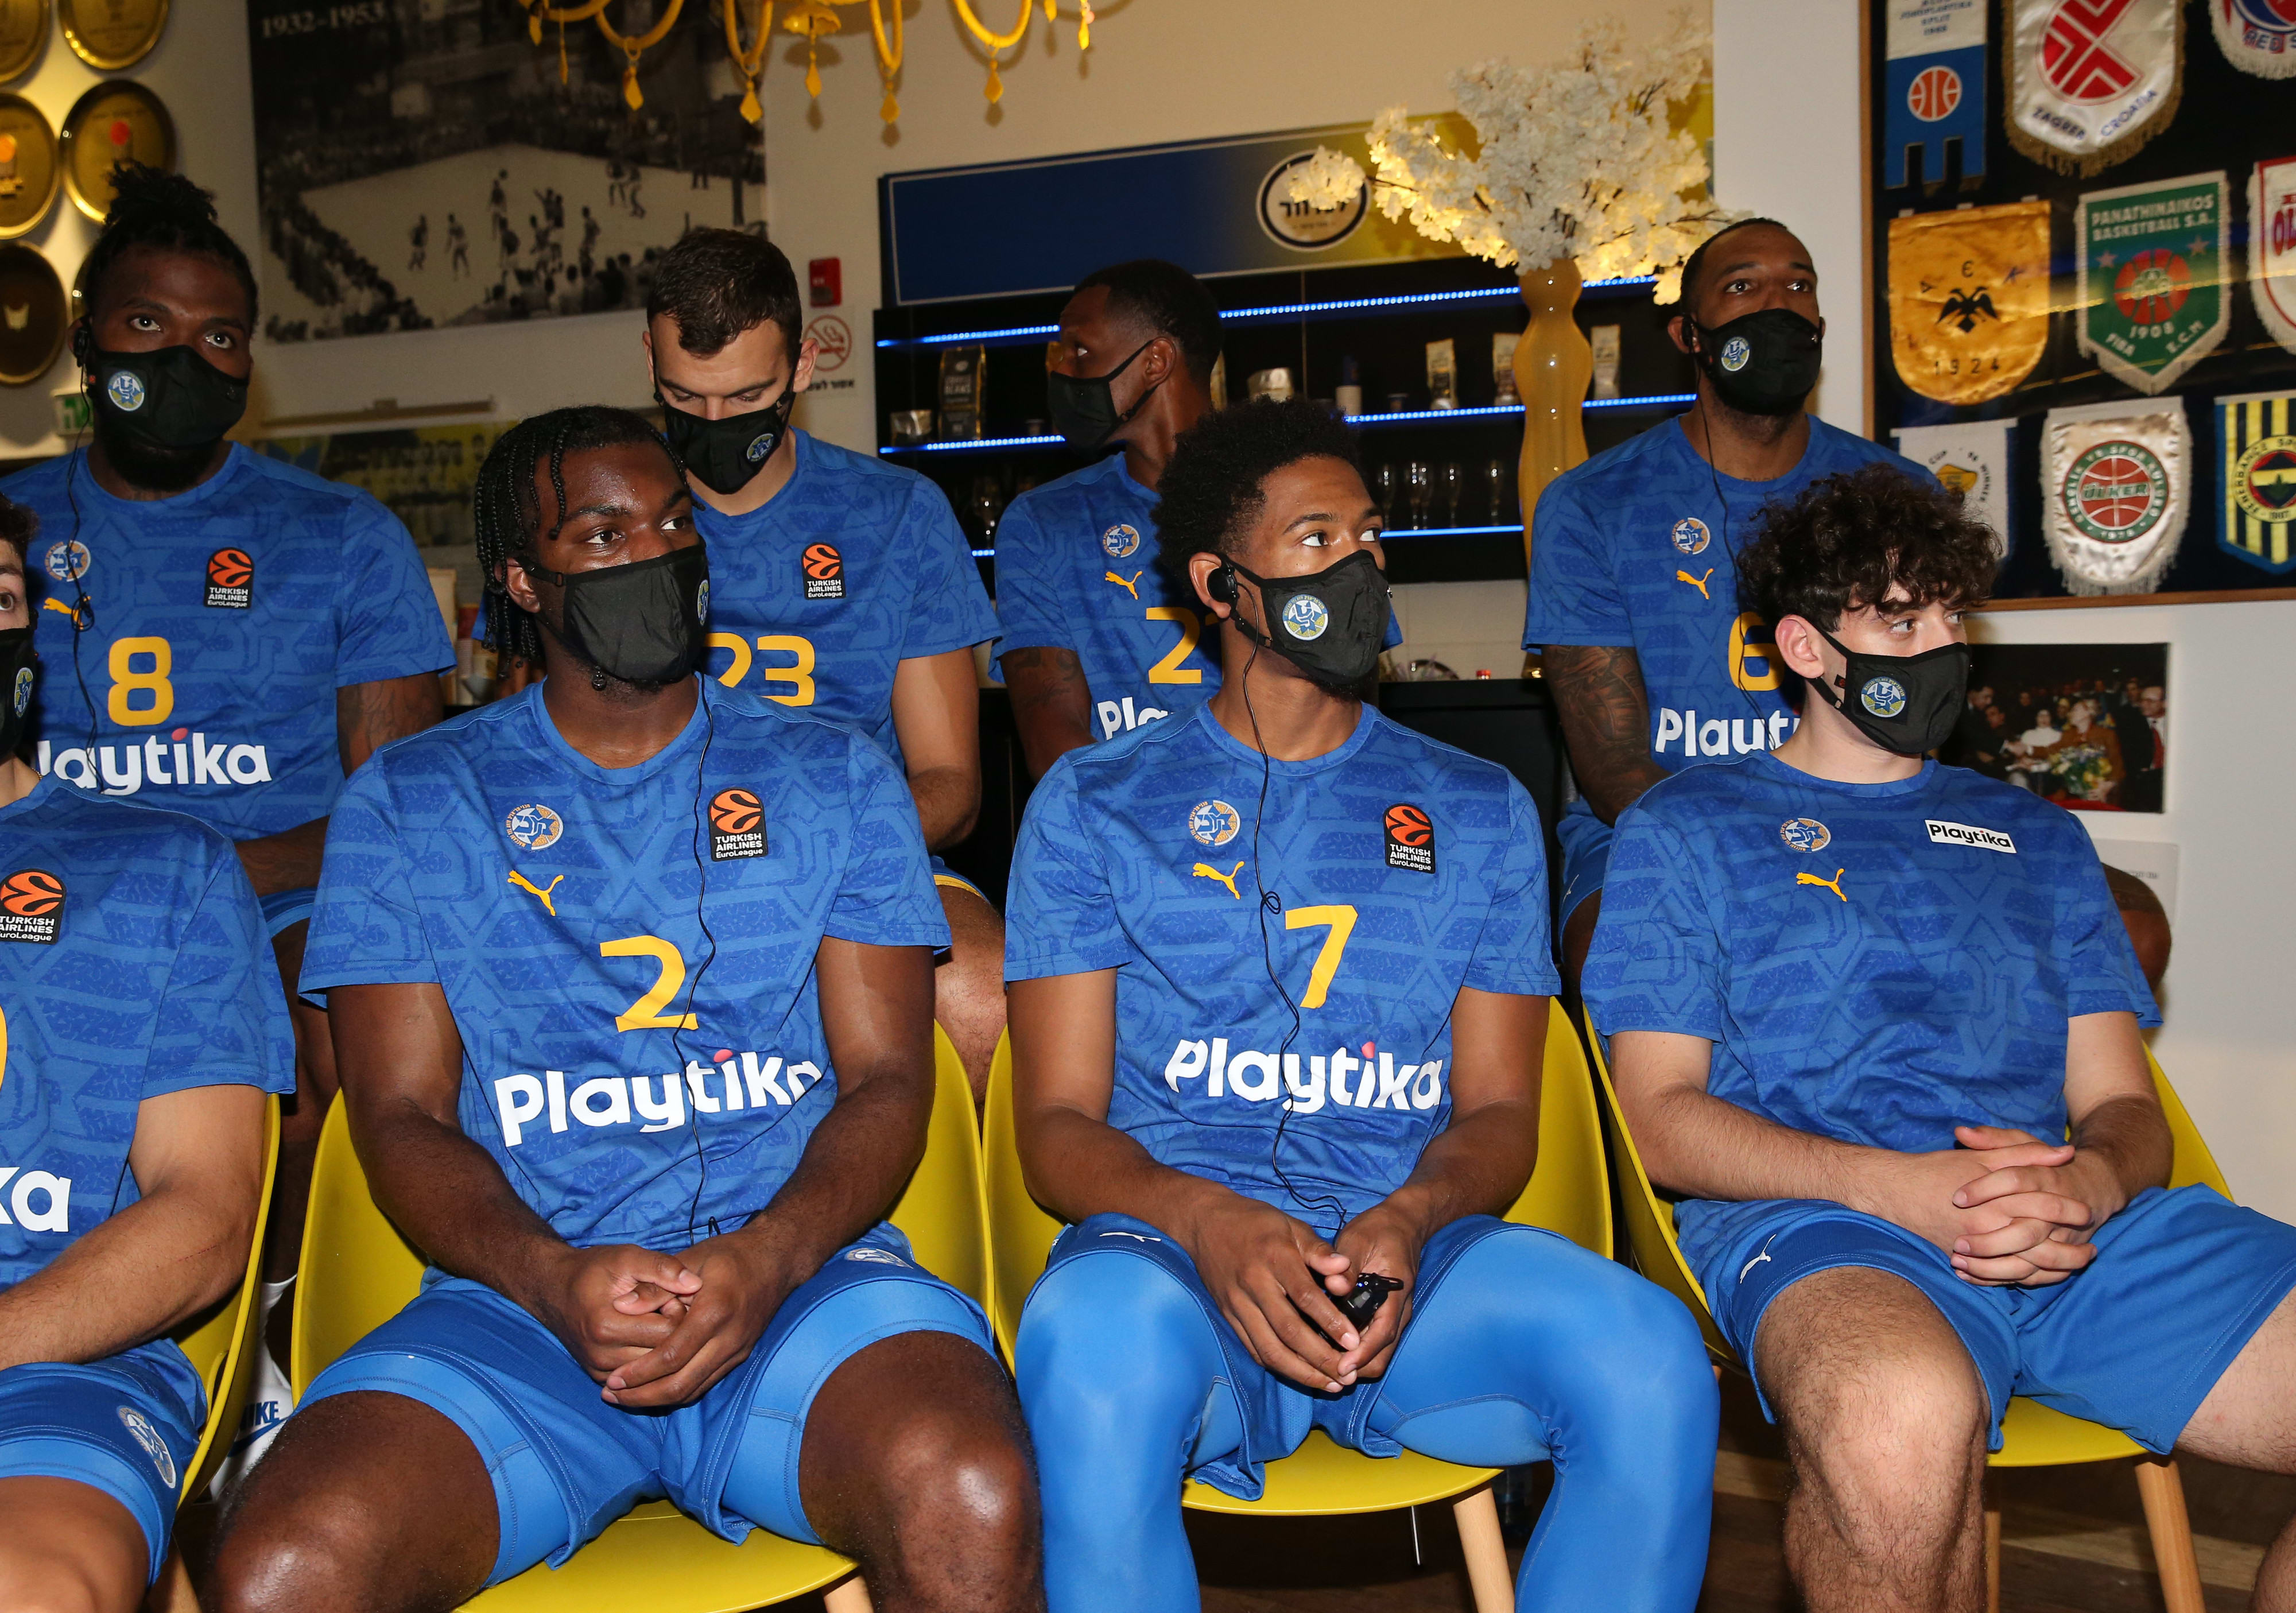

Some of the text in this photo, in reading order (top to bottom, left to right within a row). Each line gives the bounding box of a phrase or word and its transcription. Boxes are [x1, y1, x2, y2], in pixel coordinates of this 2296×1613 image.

[2092, 194, 2214, 226] PANATHINAIKOS
[2093, 217, 2180, 241] BASKETBALL
[2129, 321, 2174, 339] 1908
[210, 587, 248, 595] TURKISH
[207, 600, 247, 608] EuroLeague
[208, 594, 247, 602] AIRLINES
[1728, 611, 1785, 691] 6
[108, 636, 174, 727] 8
[37, 727, 272, 796] laytika
[715, 833, 762, 844] TURKISH
[1929, 824, 2011, 847] Playtika
[716, 840, 763, 852] AIRLINES
[1390, 844, 1430, 857] TURKISH
[716, 849, 763, 858] EuroLeague
[1390, 851, 1431, 864] AIRLINES
[1390, 858, 1432, 871] EuroLeague
[0, 916, 55, 926] TURKISH
[0, 924, 53, 934] AIRLINES
[1285, 905, 1358, 1009] 7
[600, 935, 699, 1033] 2
[1165, 1038, 1443, 1114] Playtika
